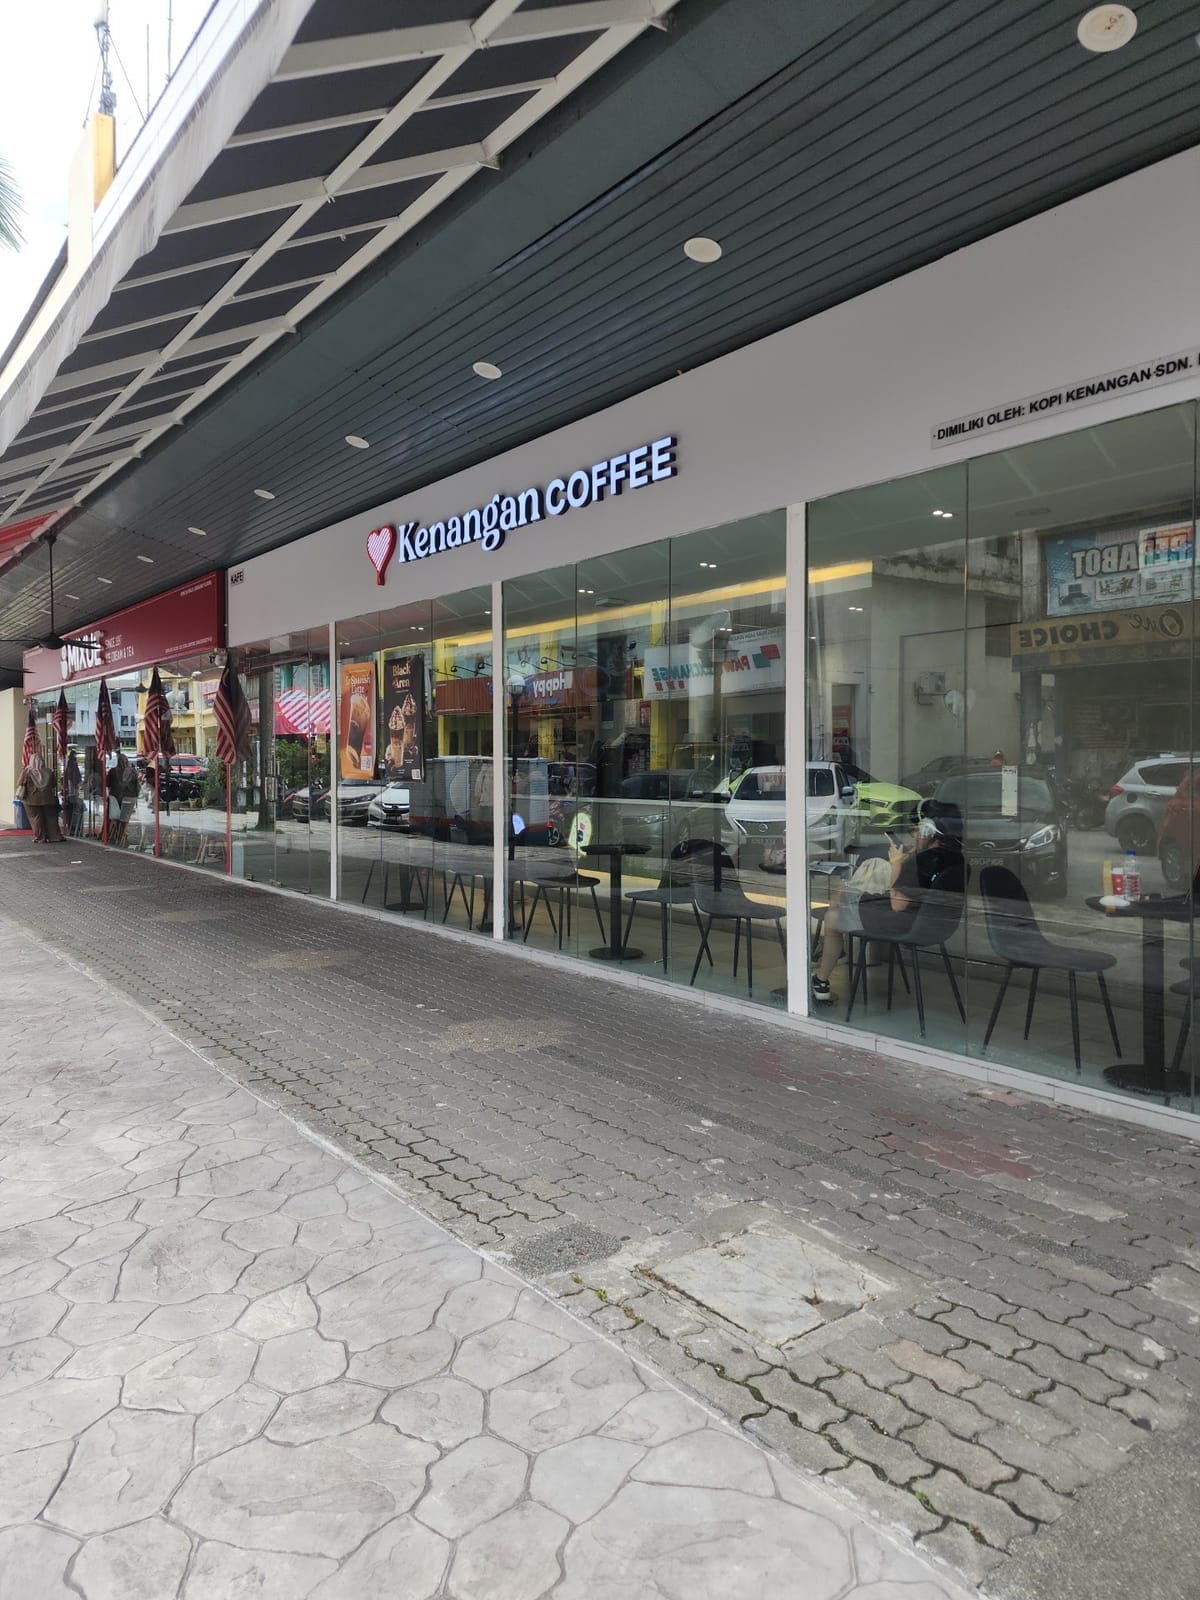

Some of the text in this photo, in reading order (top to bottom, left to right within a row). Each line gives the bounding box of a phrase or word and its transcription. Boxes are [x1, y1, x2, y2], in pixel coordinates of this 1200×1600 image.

[937, 416, 984, 440] DIMILIKI
[986, 405, 1025, 425] OLEH:
[1029, 393, 1063, 414] KOPI
[1065, 367, 1151, 402] KENANGAN
[1155, 356, 1193, 377] SDN.
[398, 436, 676, 564] Kenangan COFFEE
[230, 570, 245, 585] KAFE
